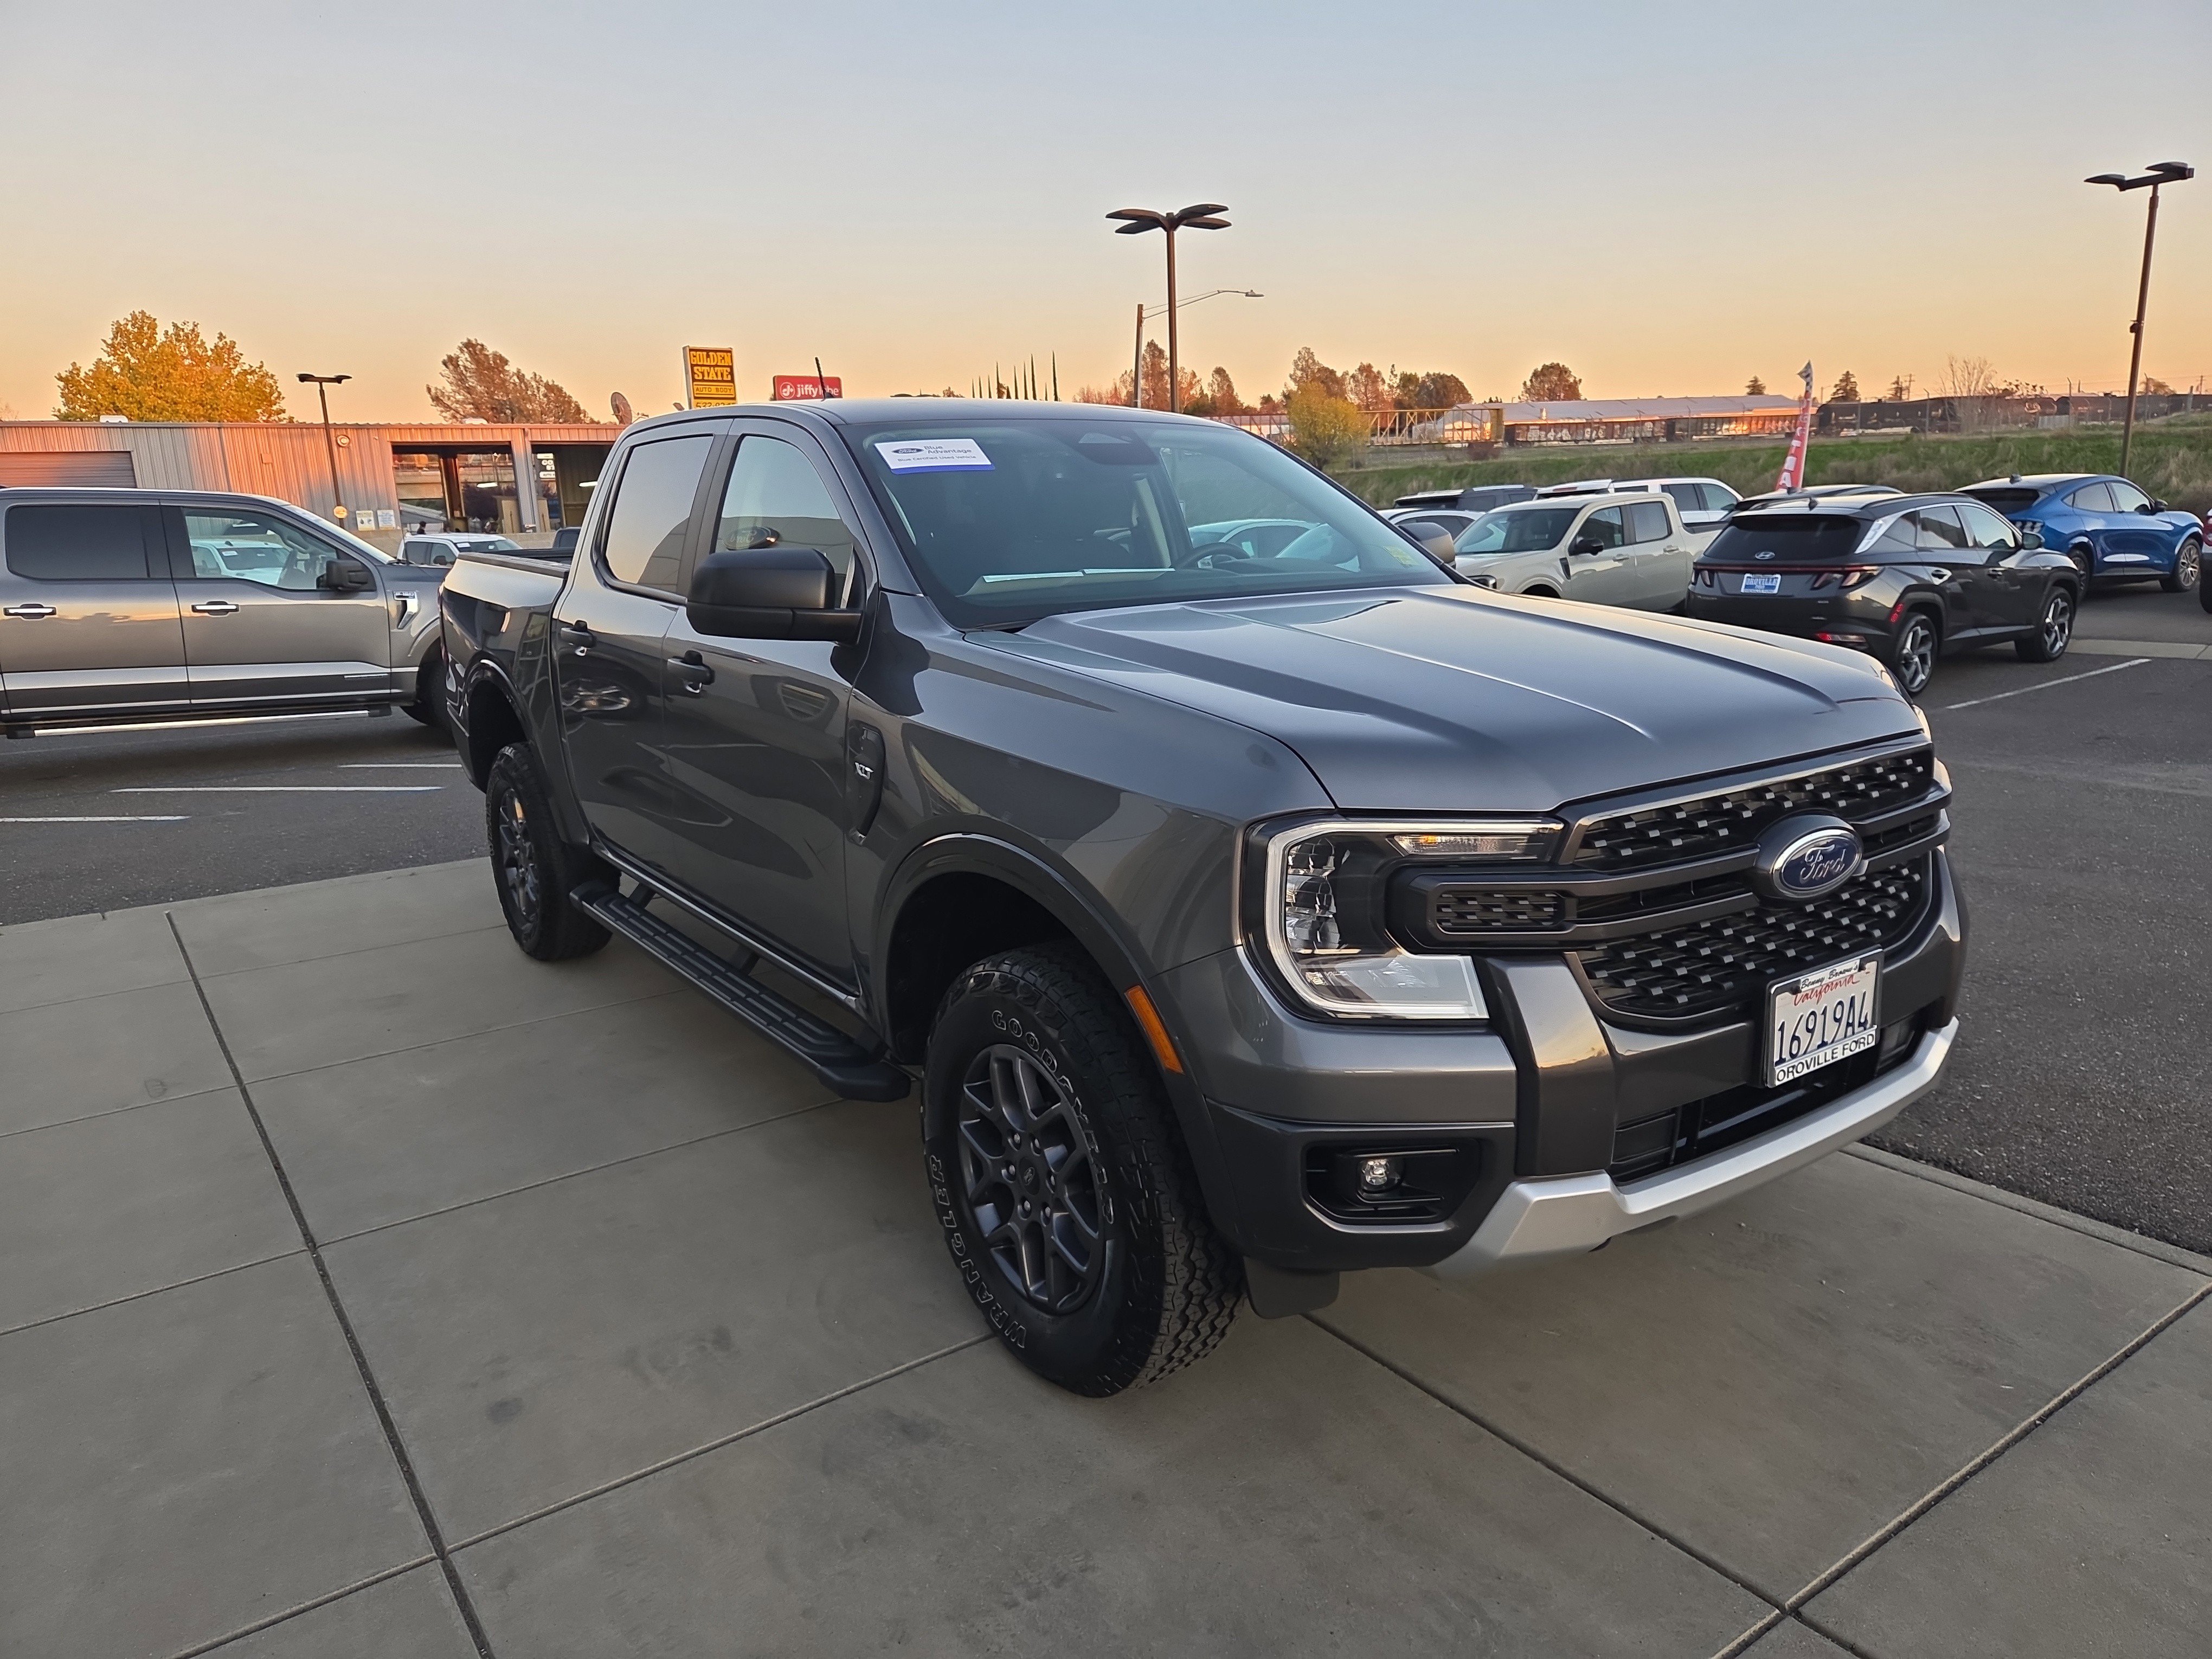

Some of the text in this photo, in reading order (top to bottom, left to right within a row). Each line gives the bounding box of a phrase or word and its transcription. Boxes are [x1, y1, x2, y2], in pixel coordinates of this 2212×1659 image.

[690, 351, 732, 365] GOLDEN
[694, 366, 731, 380] STATE
[1799, 844, 1847, 880] Ford
[1793, 974, 1860, 1006] California
[1775, 990, 1869, 1067] 16919A4
[1777, 1033, 1874, 1082] OROVILLE FORD
[929, 1155, 1026, 1348] WRANGLER
